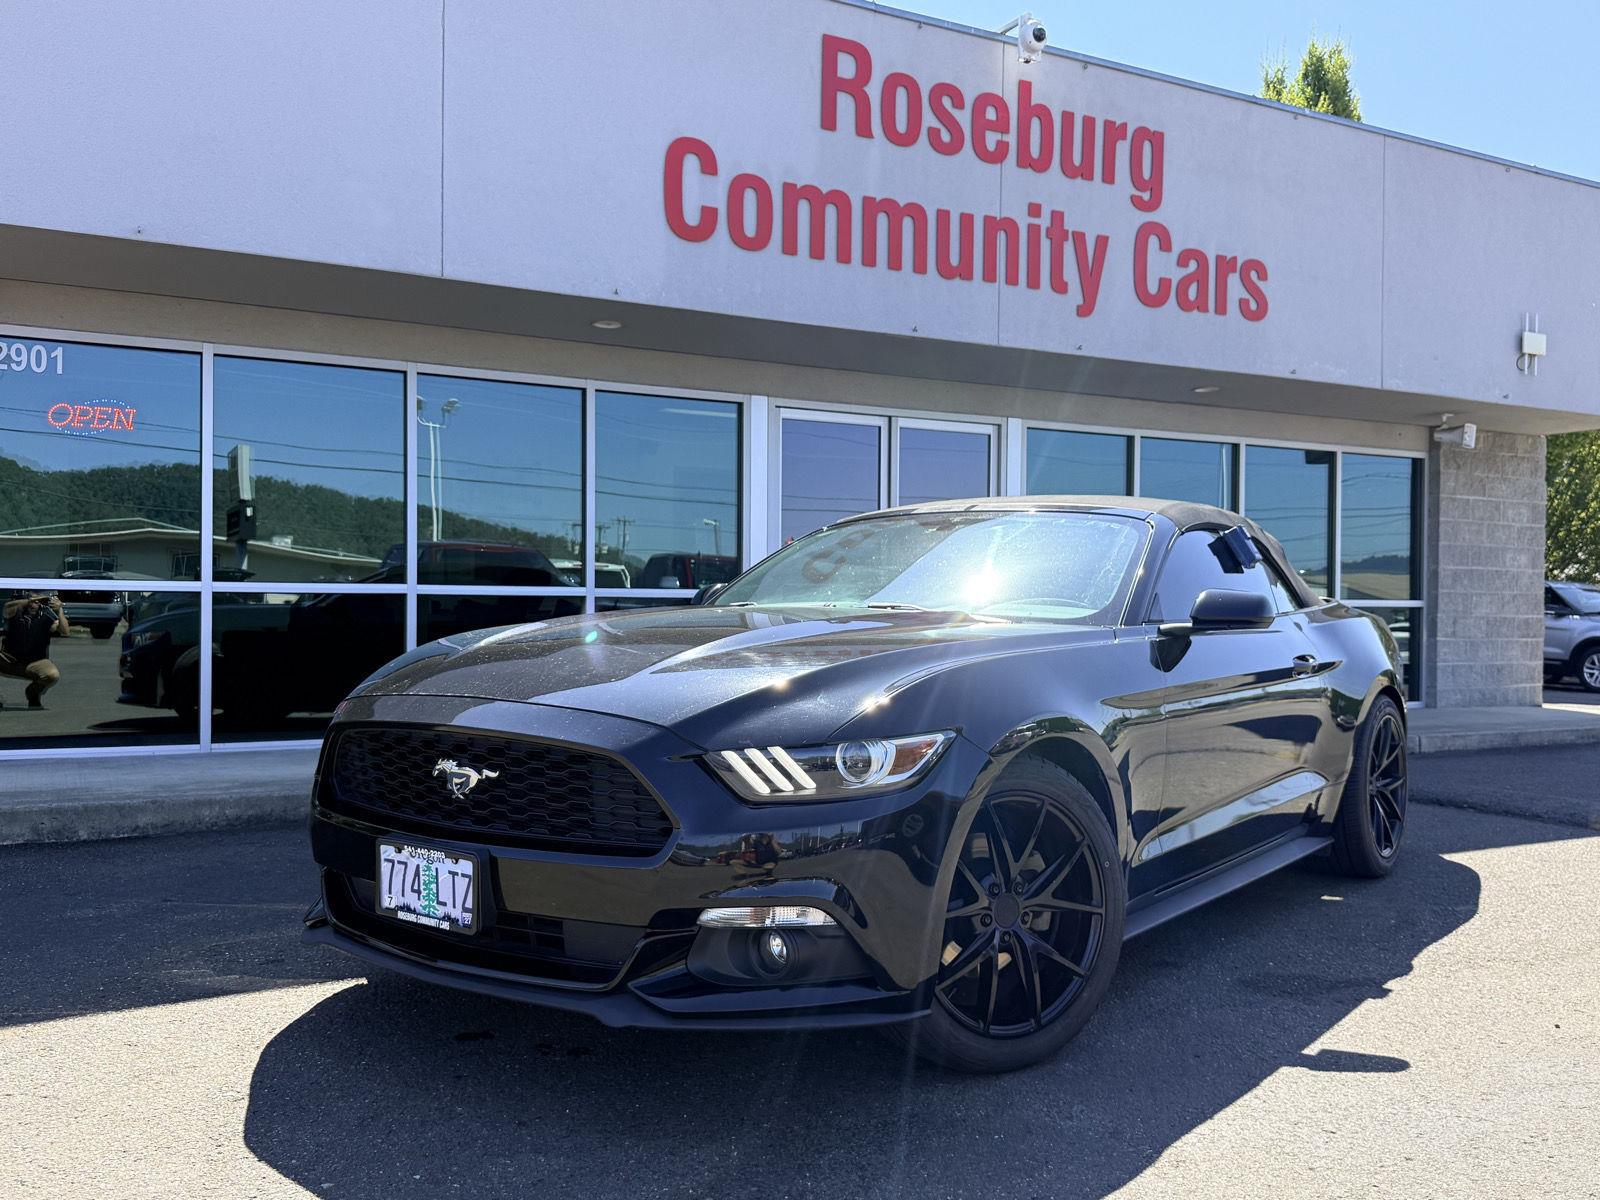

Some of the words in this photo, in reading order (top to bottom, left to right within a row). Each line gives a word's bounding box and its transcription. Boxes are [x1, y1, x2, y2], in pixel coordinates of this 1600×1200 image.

[821, 33, 1165, 212] Roseburg
[663, 136, 1109, 318] Community
[1134, 221, 1269, 322] Cars
[47, 402, 136, 430] OPEN
[384, 858, 421, 902] 774
[435, 867, 472, 913] LTZ
